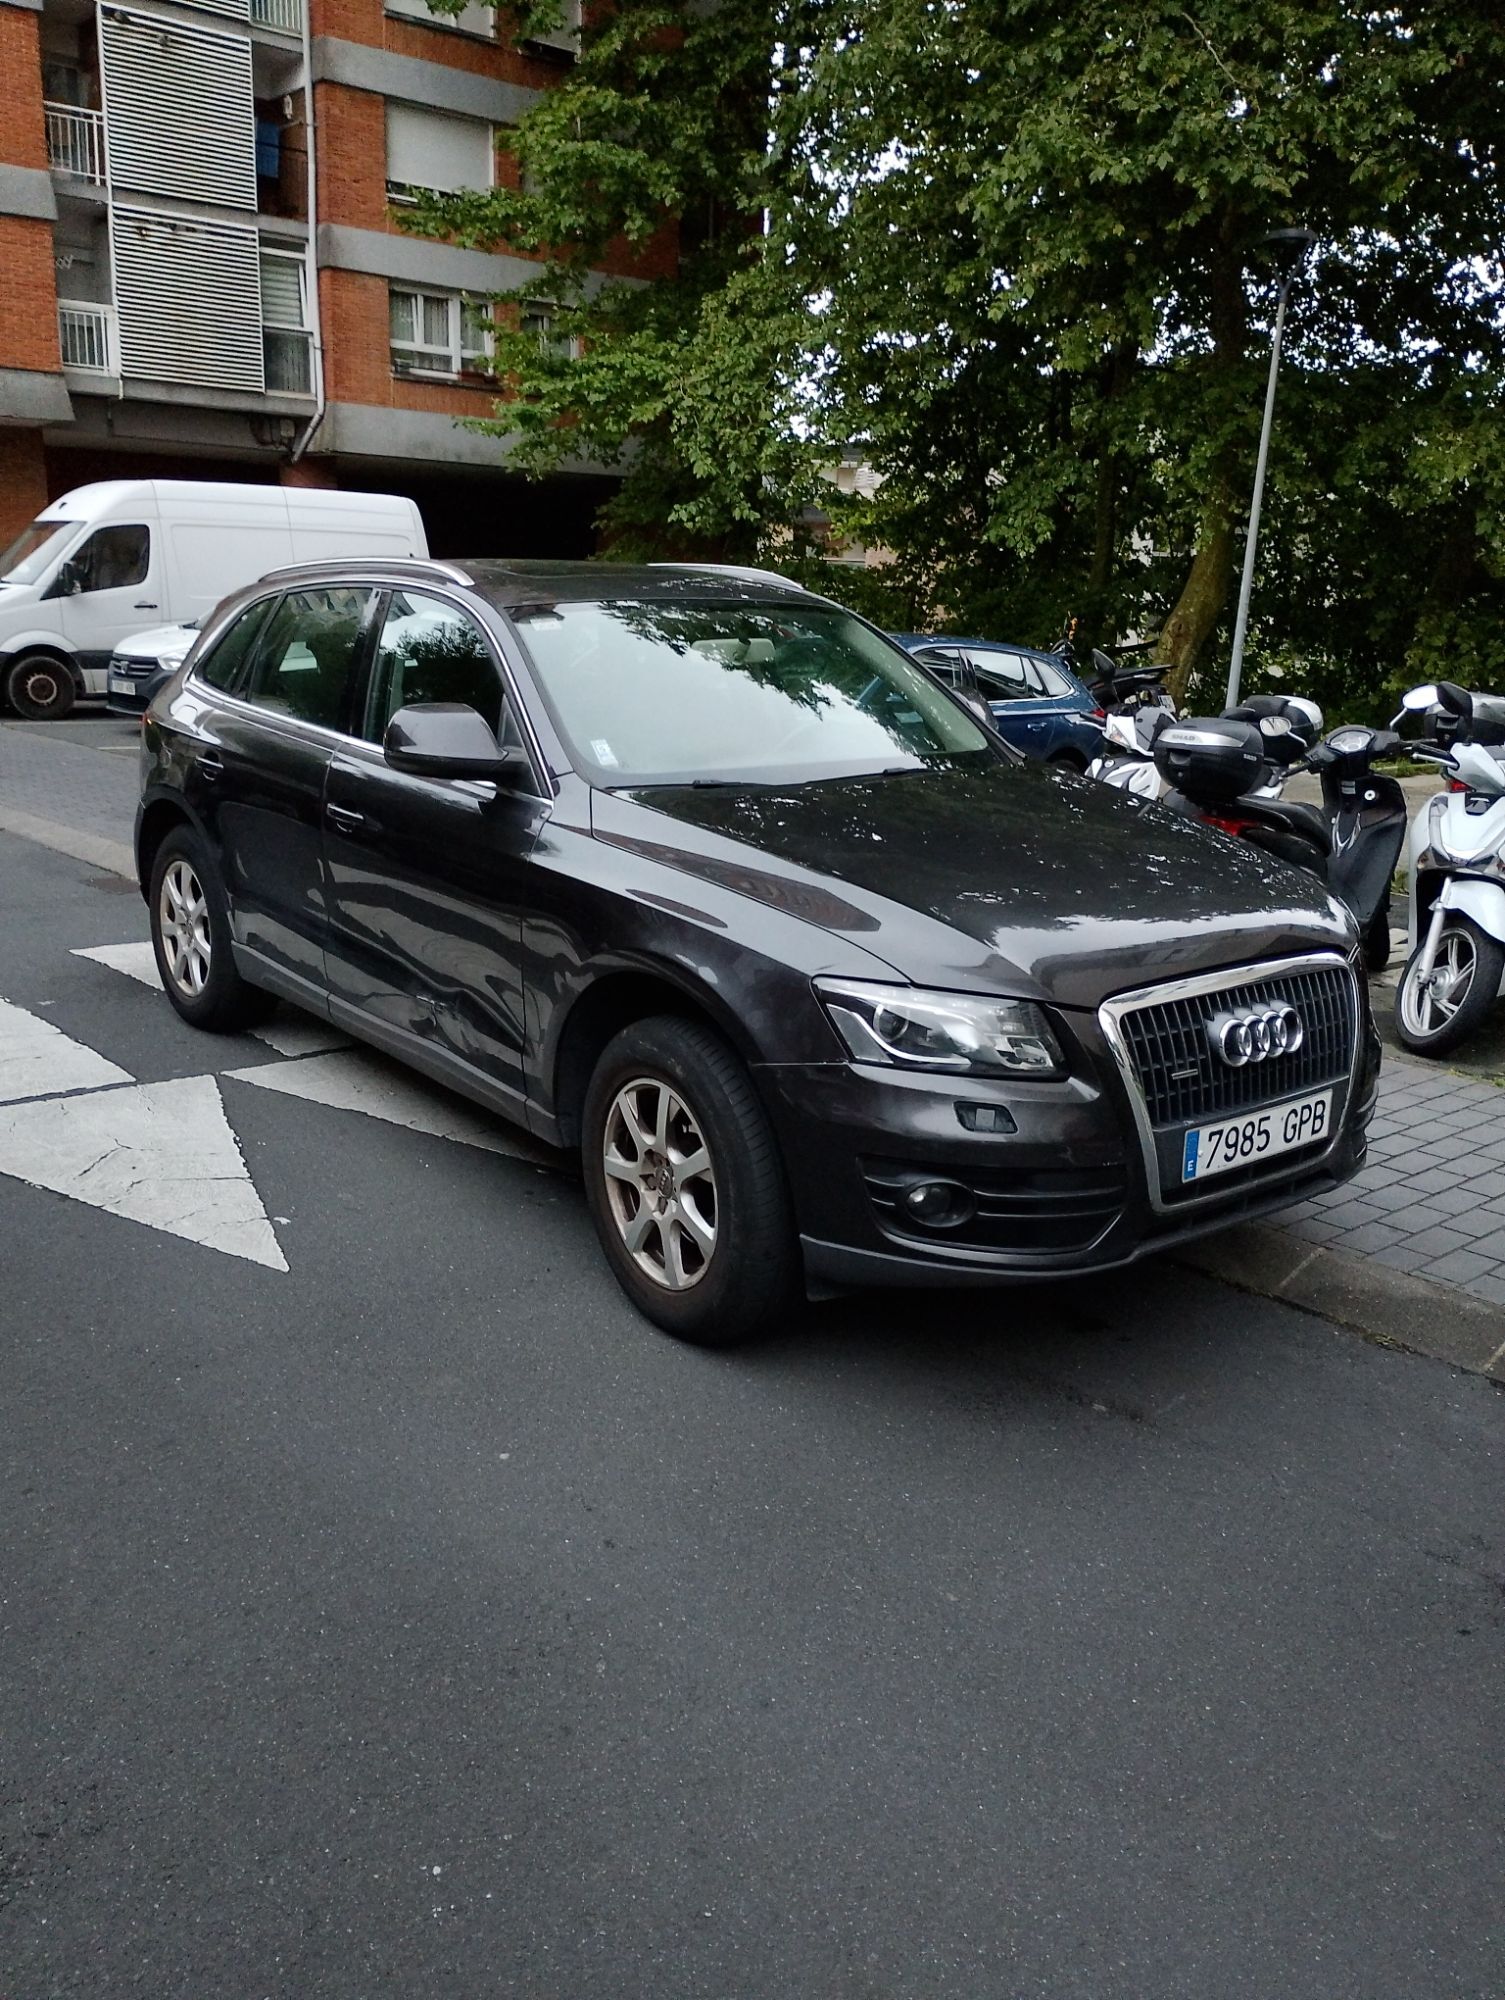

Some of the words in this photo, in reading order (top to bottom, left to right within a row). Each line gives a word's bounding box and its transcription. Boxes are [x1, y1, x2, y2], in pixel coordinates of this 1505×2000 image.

[1187, 1159, 1194, 1171] E
[1205, 1115, 1271, 1169] 7985
[1282, 1099, 1326, 1144] GPB
